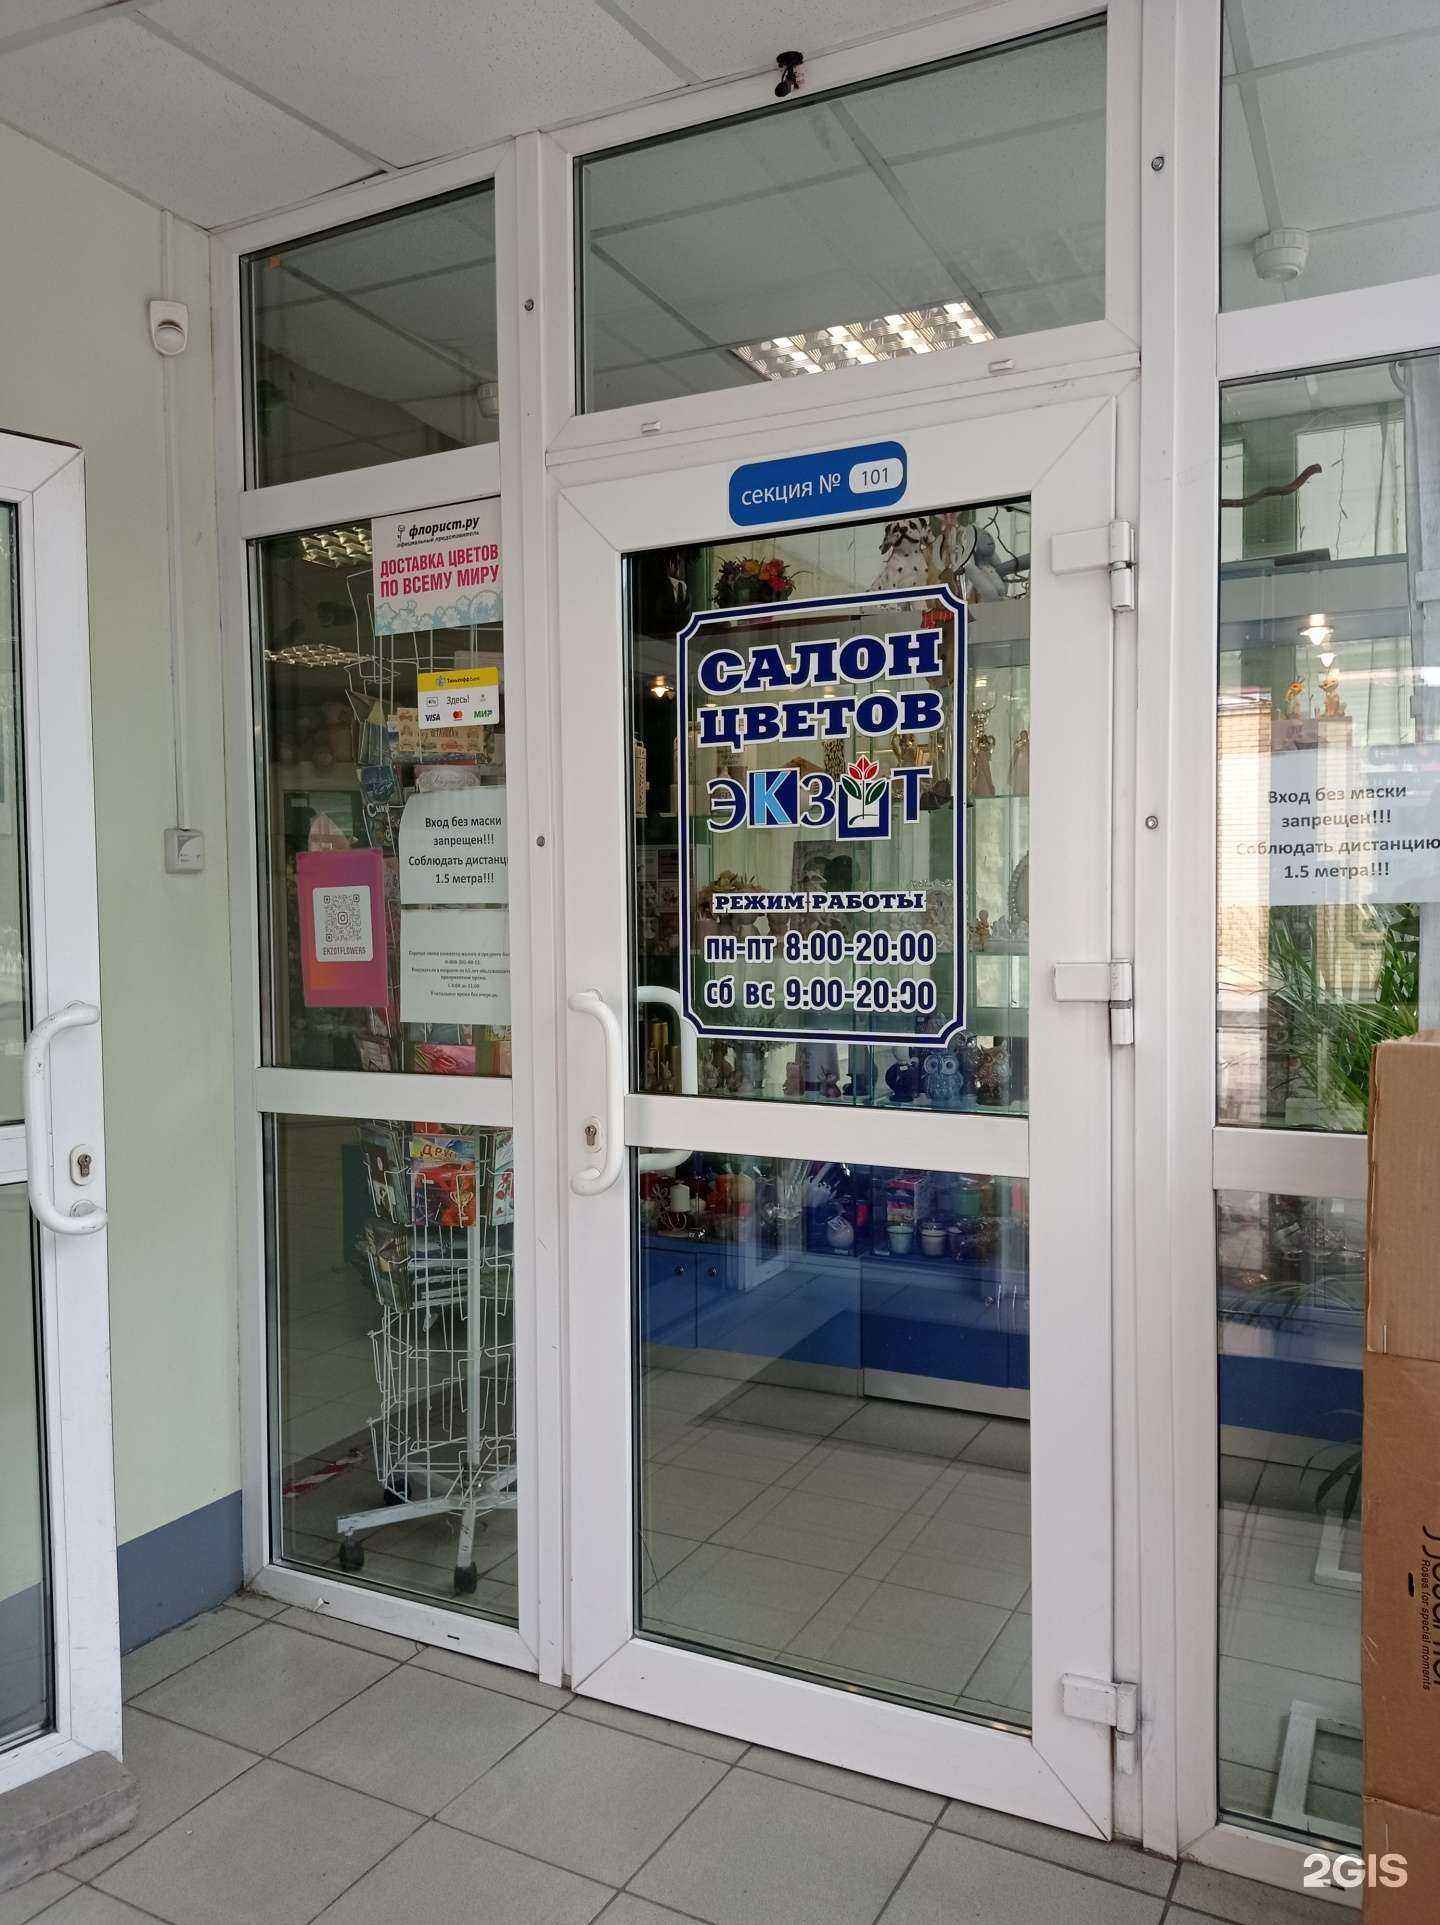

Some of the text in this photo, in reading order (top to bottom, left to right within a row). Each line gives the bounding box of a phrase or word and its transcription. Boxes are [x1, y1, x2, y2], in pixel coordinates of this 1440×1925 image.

[741, 466, 890, 506] секция № 101
[408, 516, 480, 540] флорист.ру
[380, 543, 499, 579] ДОСТАВКА ЦВЕТОВ
[380, 564, 500, 598] ПО ВСЕМУ МИРУ
[699, 628, 943, 694] САЛОН
[425, 713, 441, 722] VISA
[473, 710, 493, 719] МИР
[698, 691, 944, 752] ЦВЕТОВ
[1269, 785, 1407, 805] Вход без маски
[425, 816, 502, 829] Вход без маски
[1281, 809, 1391, 830] запрещен!!!
[433, 833, 494, 848] запрещен!!!
[1236, 838, 1440, 856] Соблюдать дистанцию
[408, 855, 508, 867] Соблюдать дистанц
[1284, 862, 1390, 880] 1.5 метра!!!
[435, 872, 494, 886] 1.5 метра!!!
[714, 892, 925, 911] РЕЖИМ РАБОТЫ
[785, 931, 936, 963] 8:00-20:00
[1420, 1559, 1431, 1691] Roses for special moments
